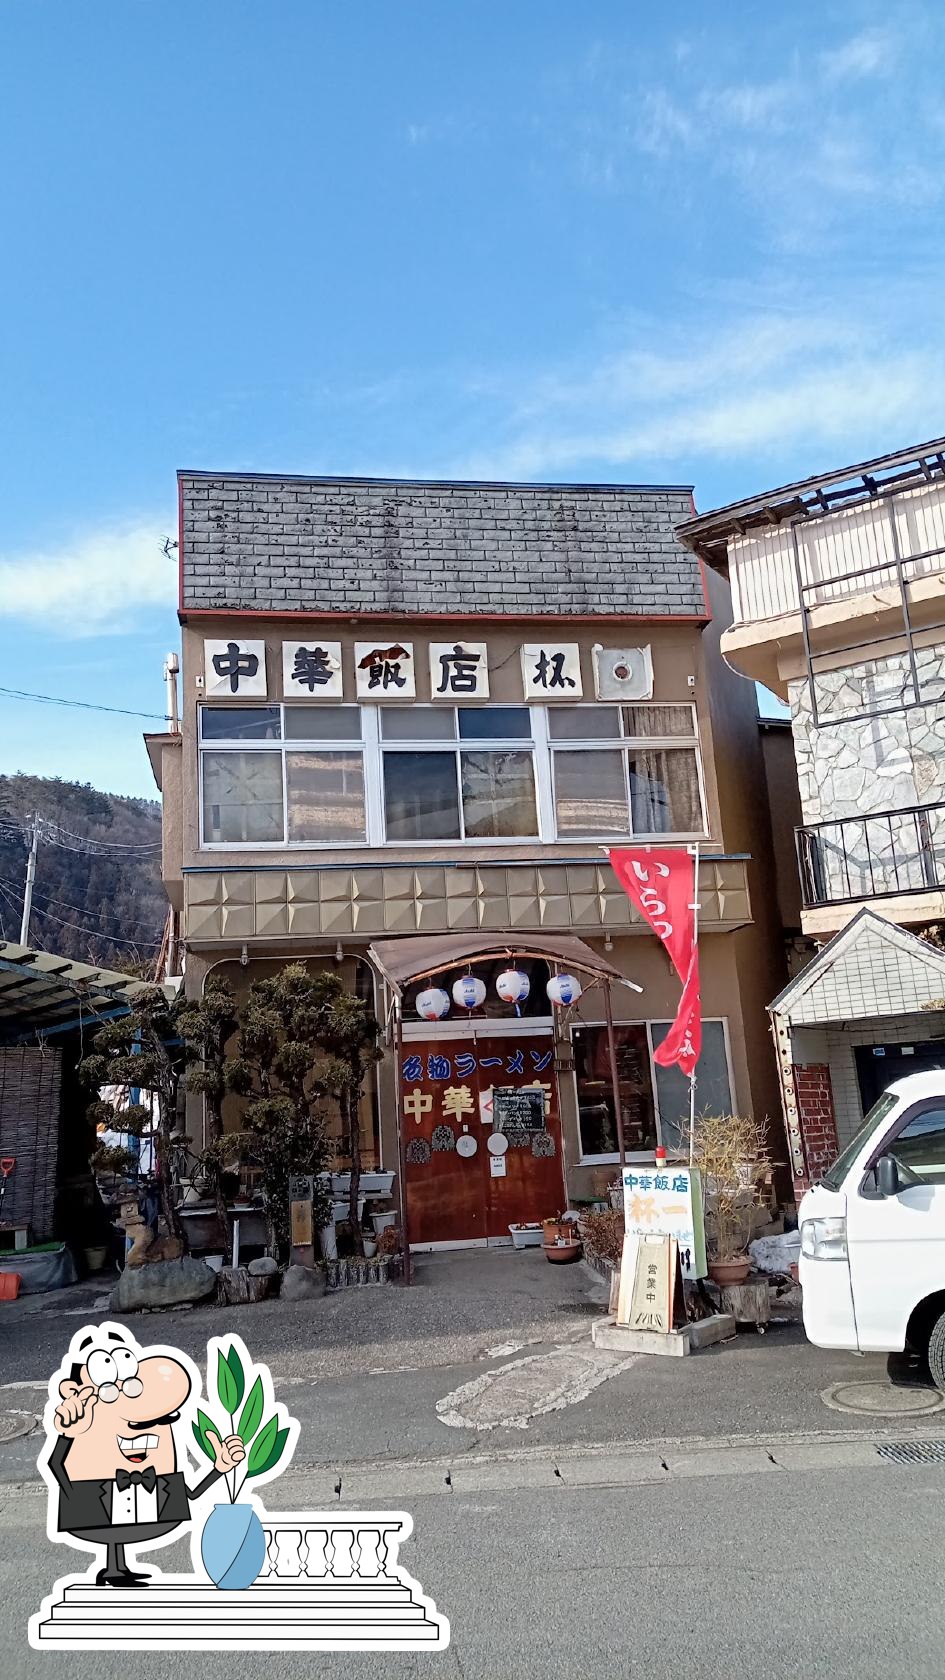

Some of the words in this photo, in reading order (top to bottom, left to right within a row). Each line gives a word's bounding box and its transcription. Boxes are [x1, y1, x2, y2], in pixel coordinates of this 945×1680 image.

[403, 1079, 553, 1125] 中華
[624, 1173, 689, 1193] 中華飯店
[646, 1264, 658, 1304] 営業中
